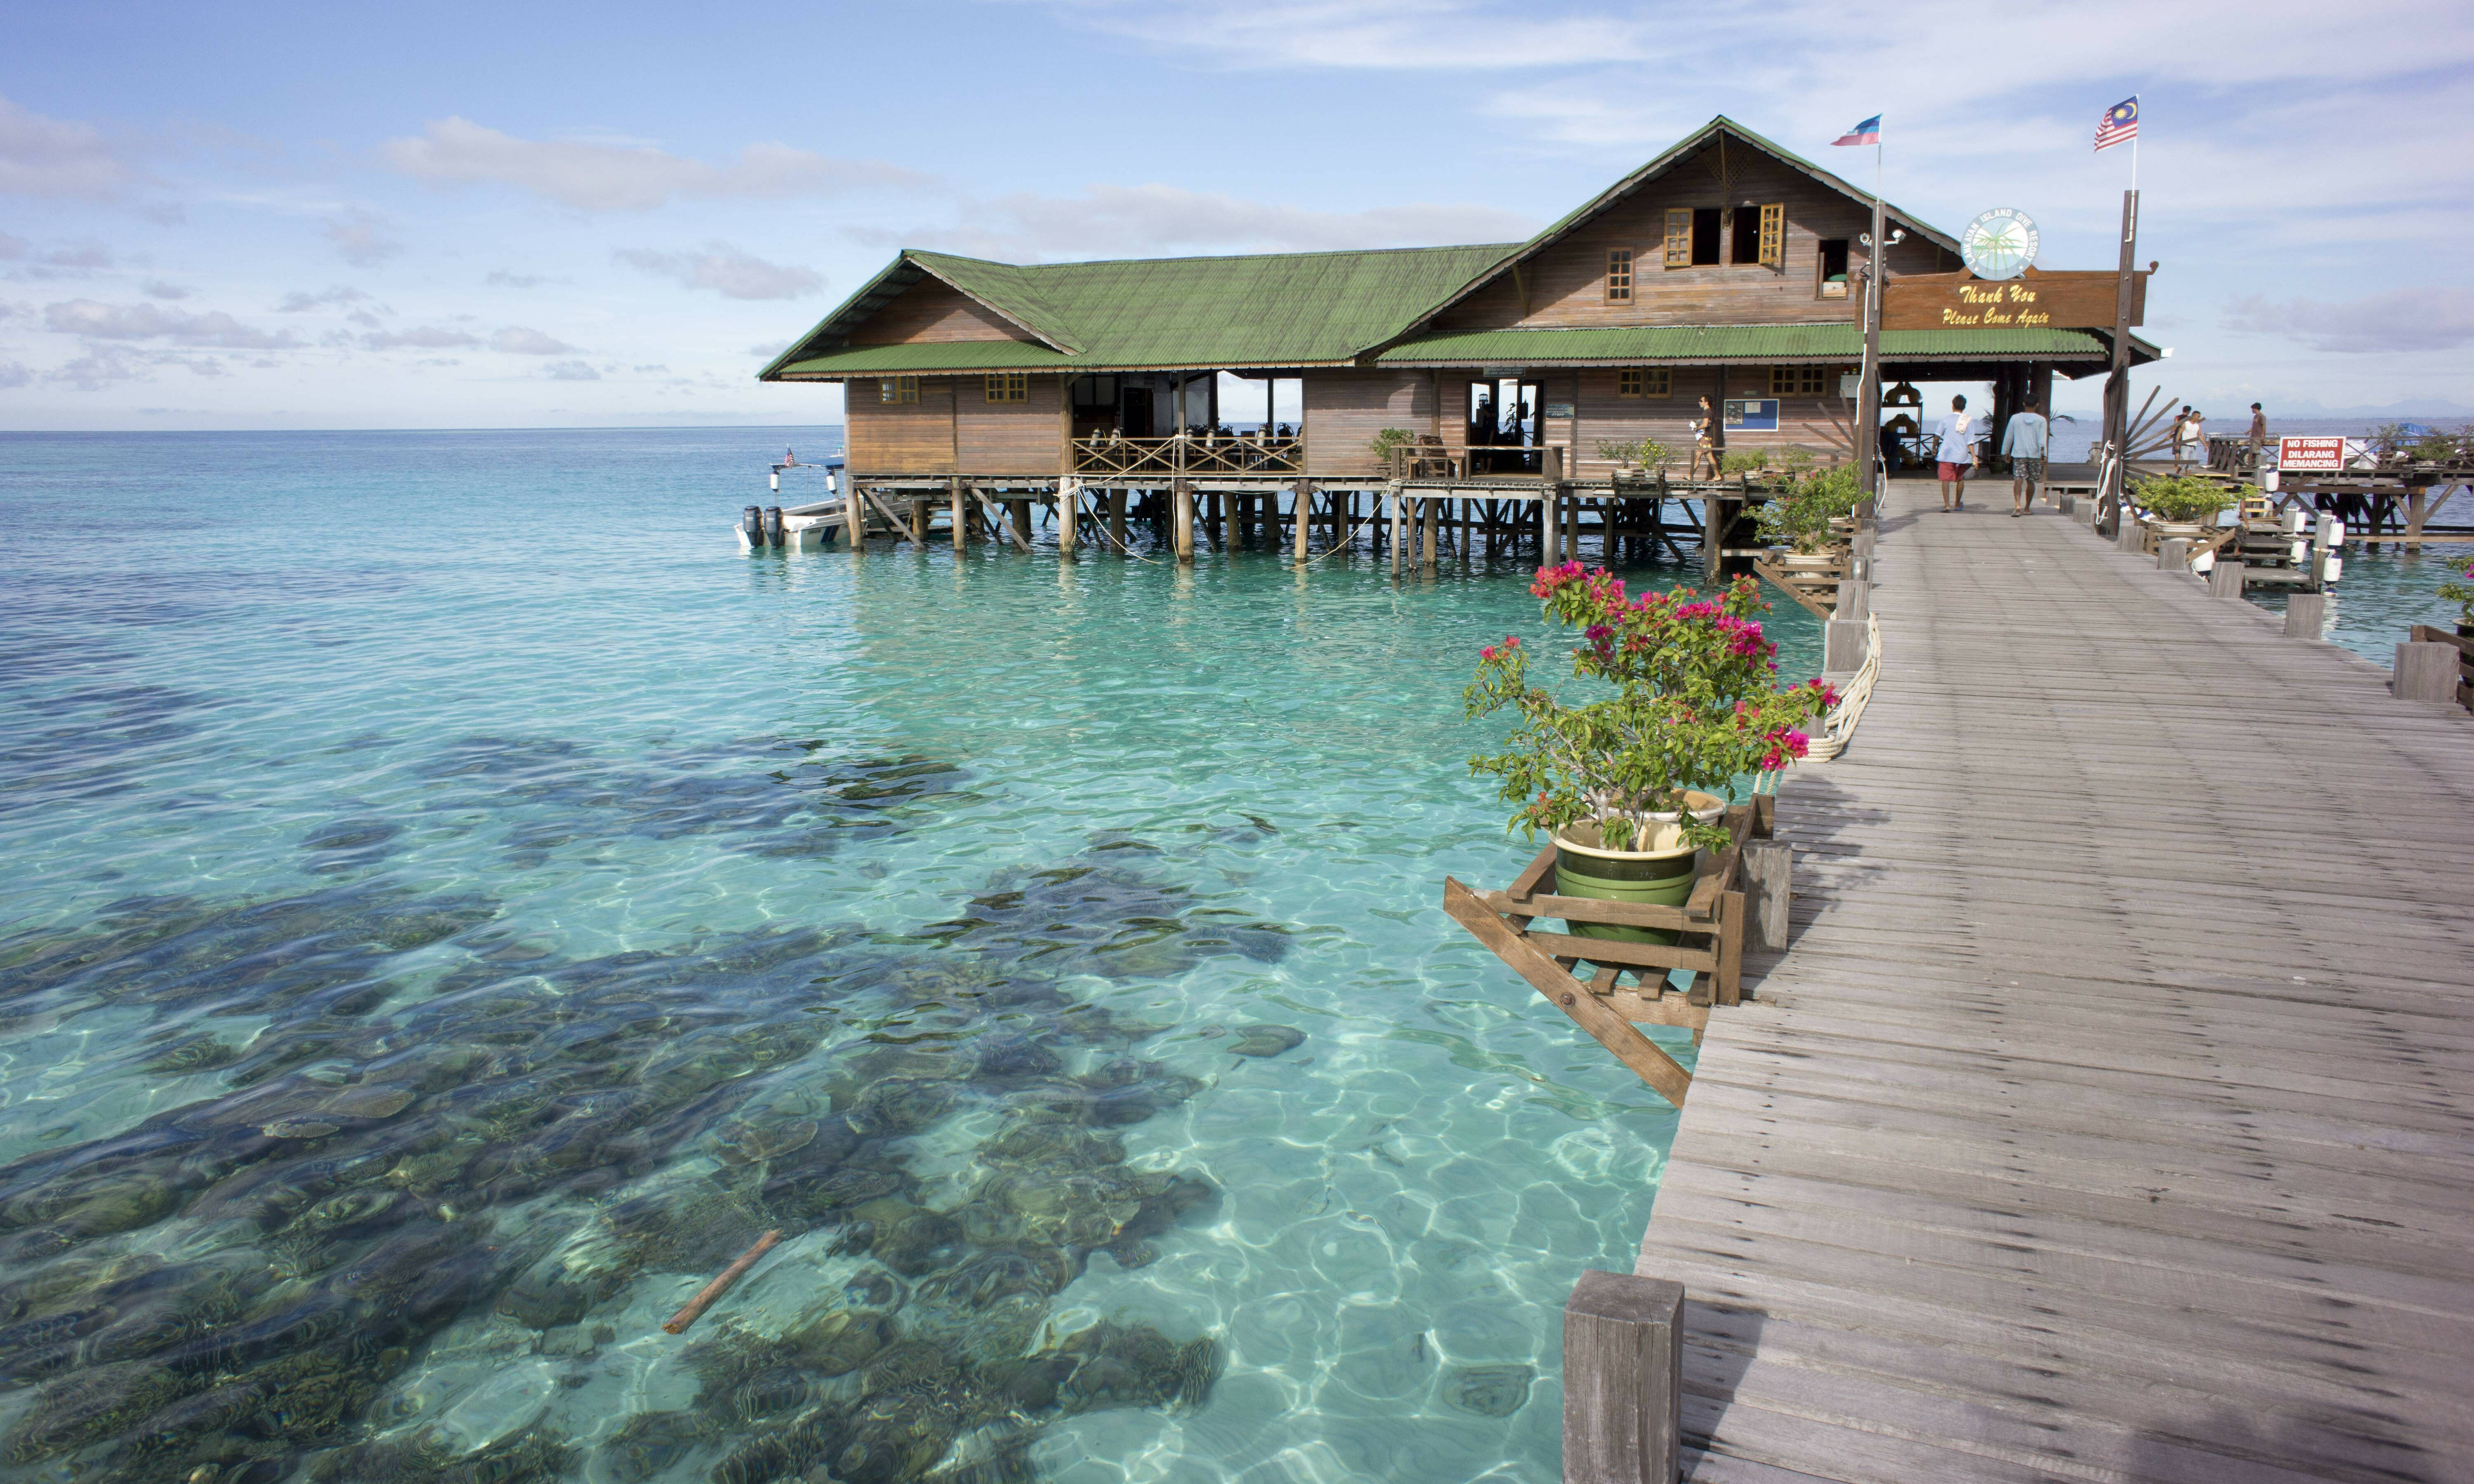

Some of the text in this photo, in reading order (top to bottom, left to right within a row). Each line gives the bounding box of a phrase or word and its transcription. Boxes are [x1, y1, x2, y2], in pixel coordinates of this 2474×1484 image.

[1963, 209, 2037, 265] LANKAYAN ISLAND DIVE RESORT
[1959, 284, 2036, 303] Thank You
[1943, 307, 2049, 328] Please Come Again
